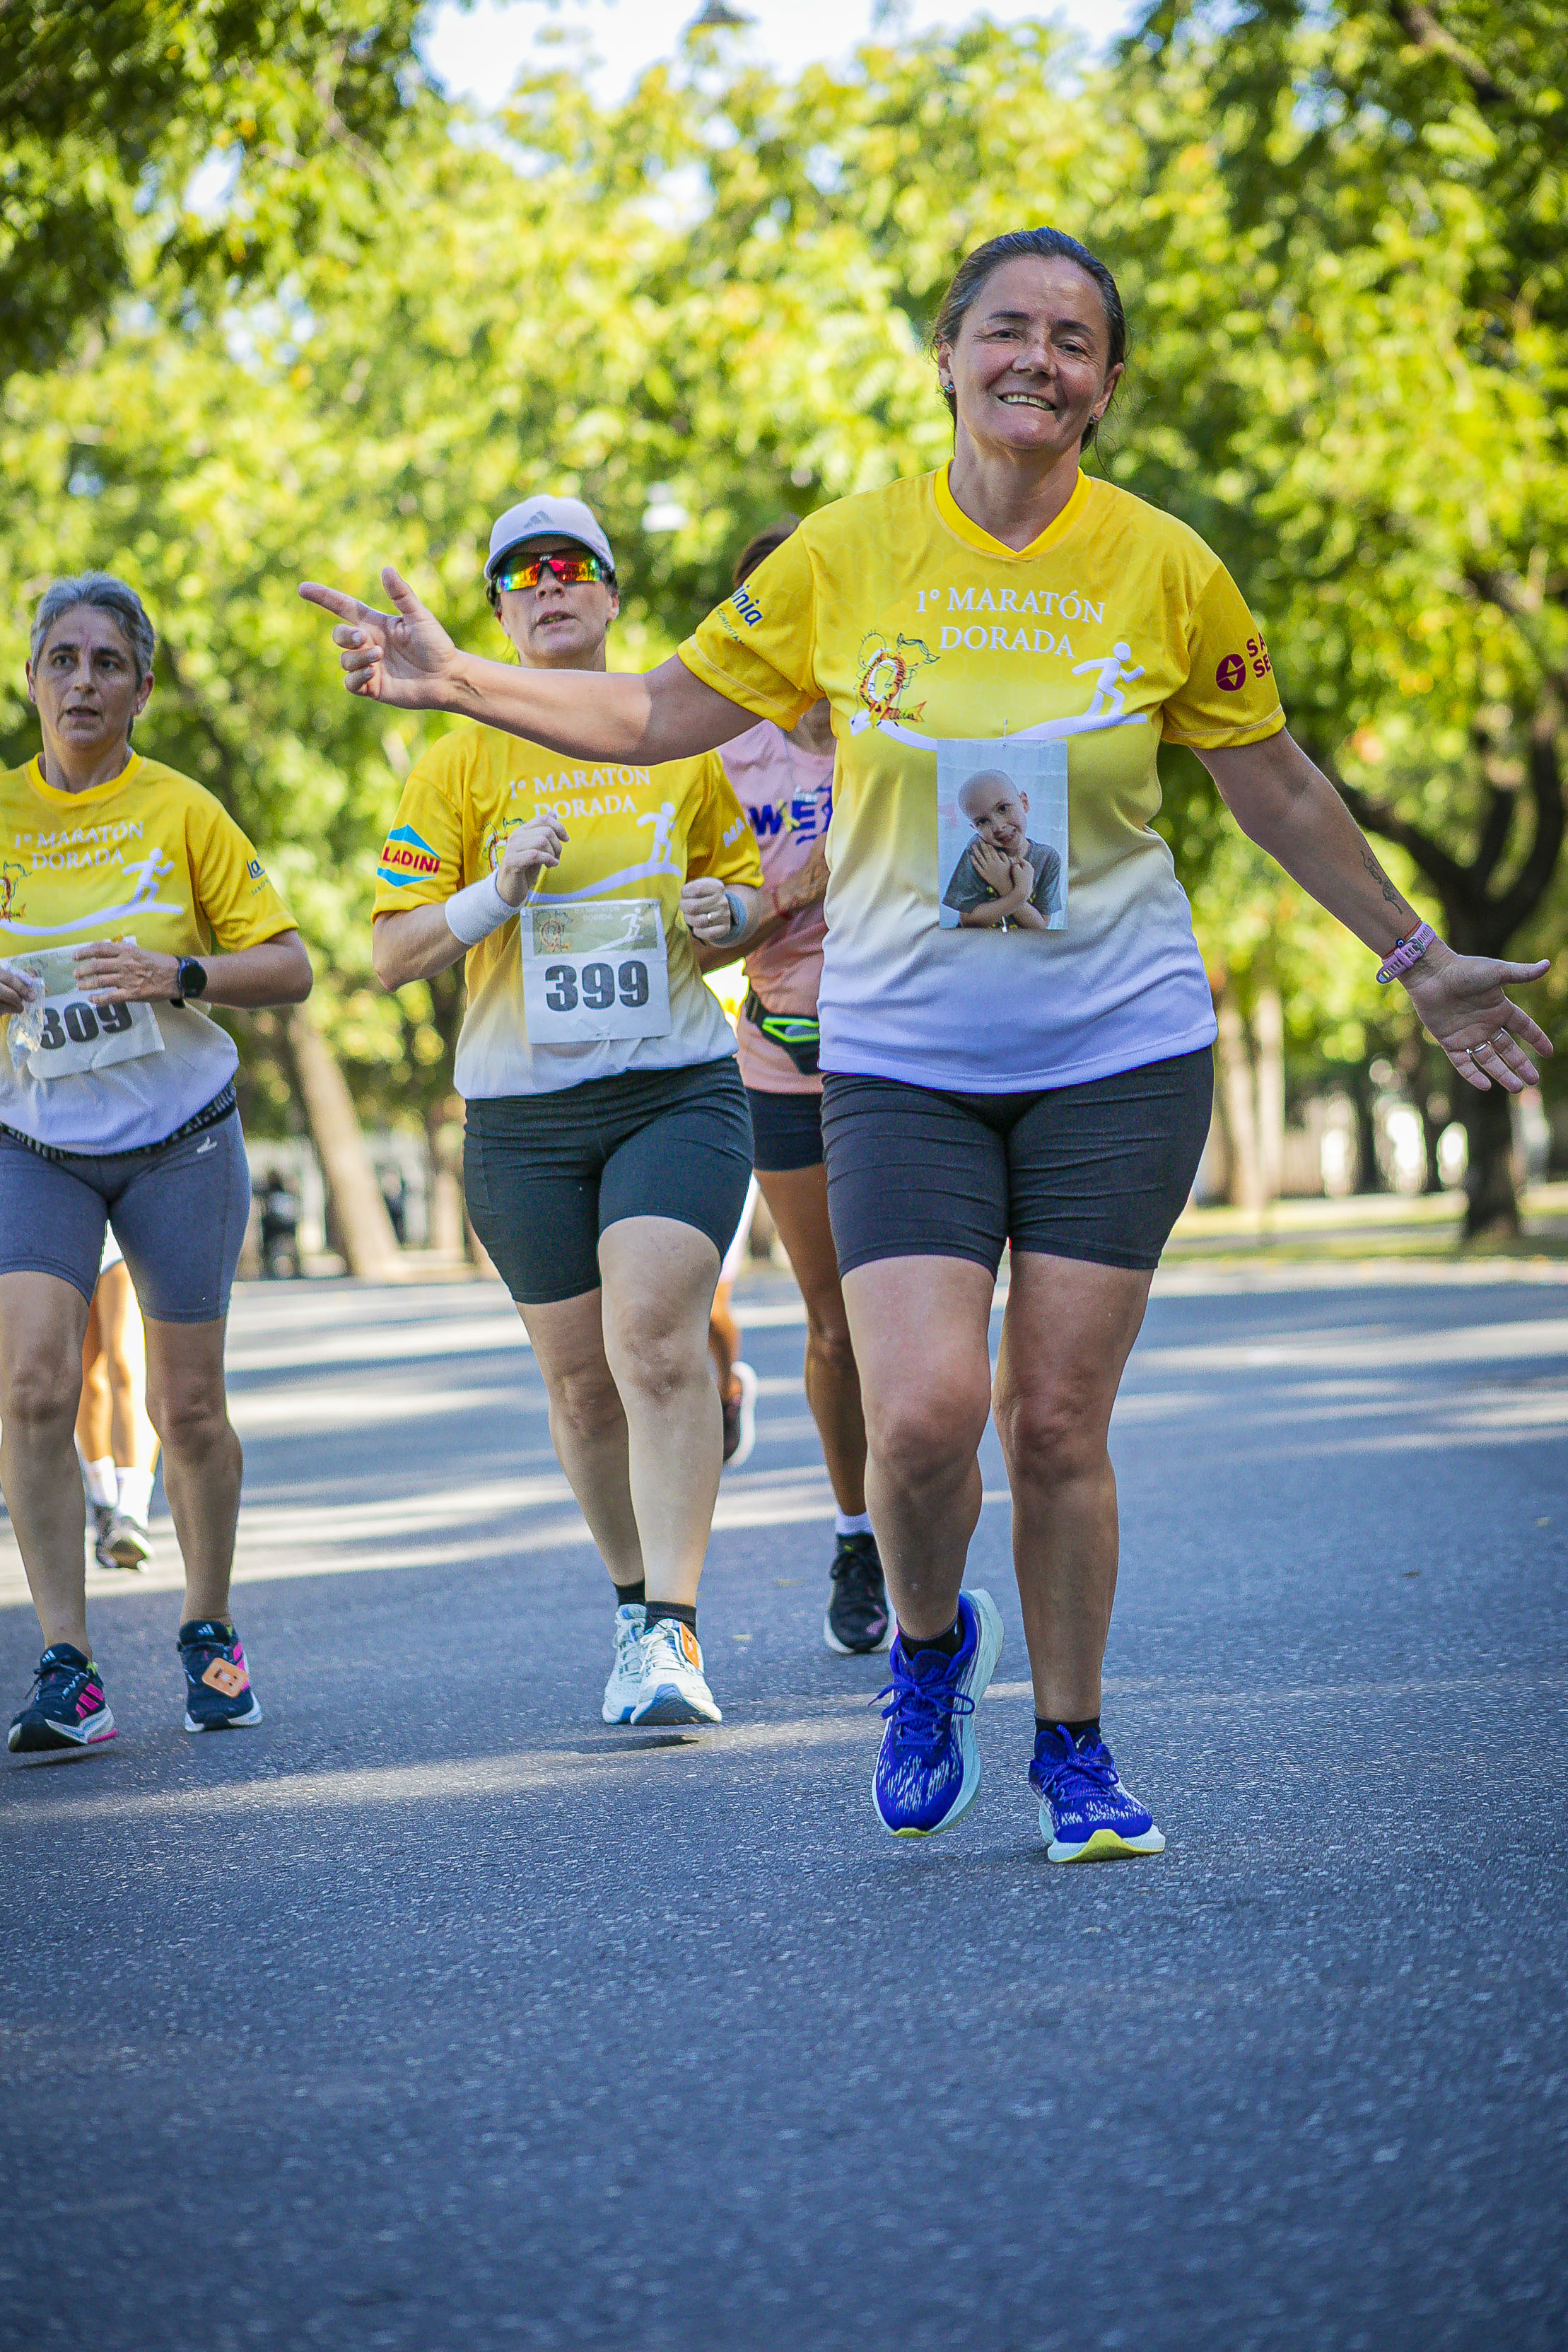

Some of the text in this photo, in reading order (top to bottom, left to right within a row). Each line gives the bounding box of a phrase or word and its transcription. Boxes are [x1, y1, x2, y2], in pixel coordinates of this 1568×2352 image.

[731, 583, 763, 627] inia
[947, 587, 1106, 625] MARATÓN
[939, 626, 1075, 658] DORADA
[534, 795, 637, 819] DORADA
[37, 821, 144, 848] MARATÓN
[723, 817, 750, 848] MA
[32, 848, 124, 870] DORADA
[380, 846, 440, 874] LADINI
[545, 960, 649, 1012] 399
[40, 1001, 133, 1050] 309
